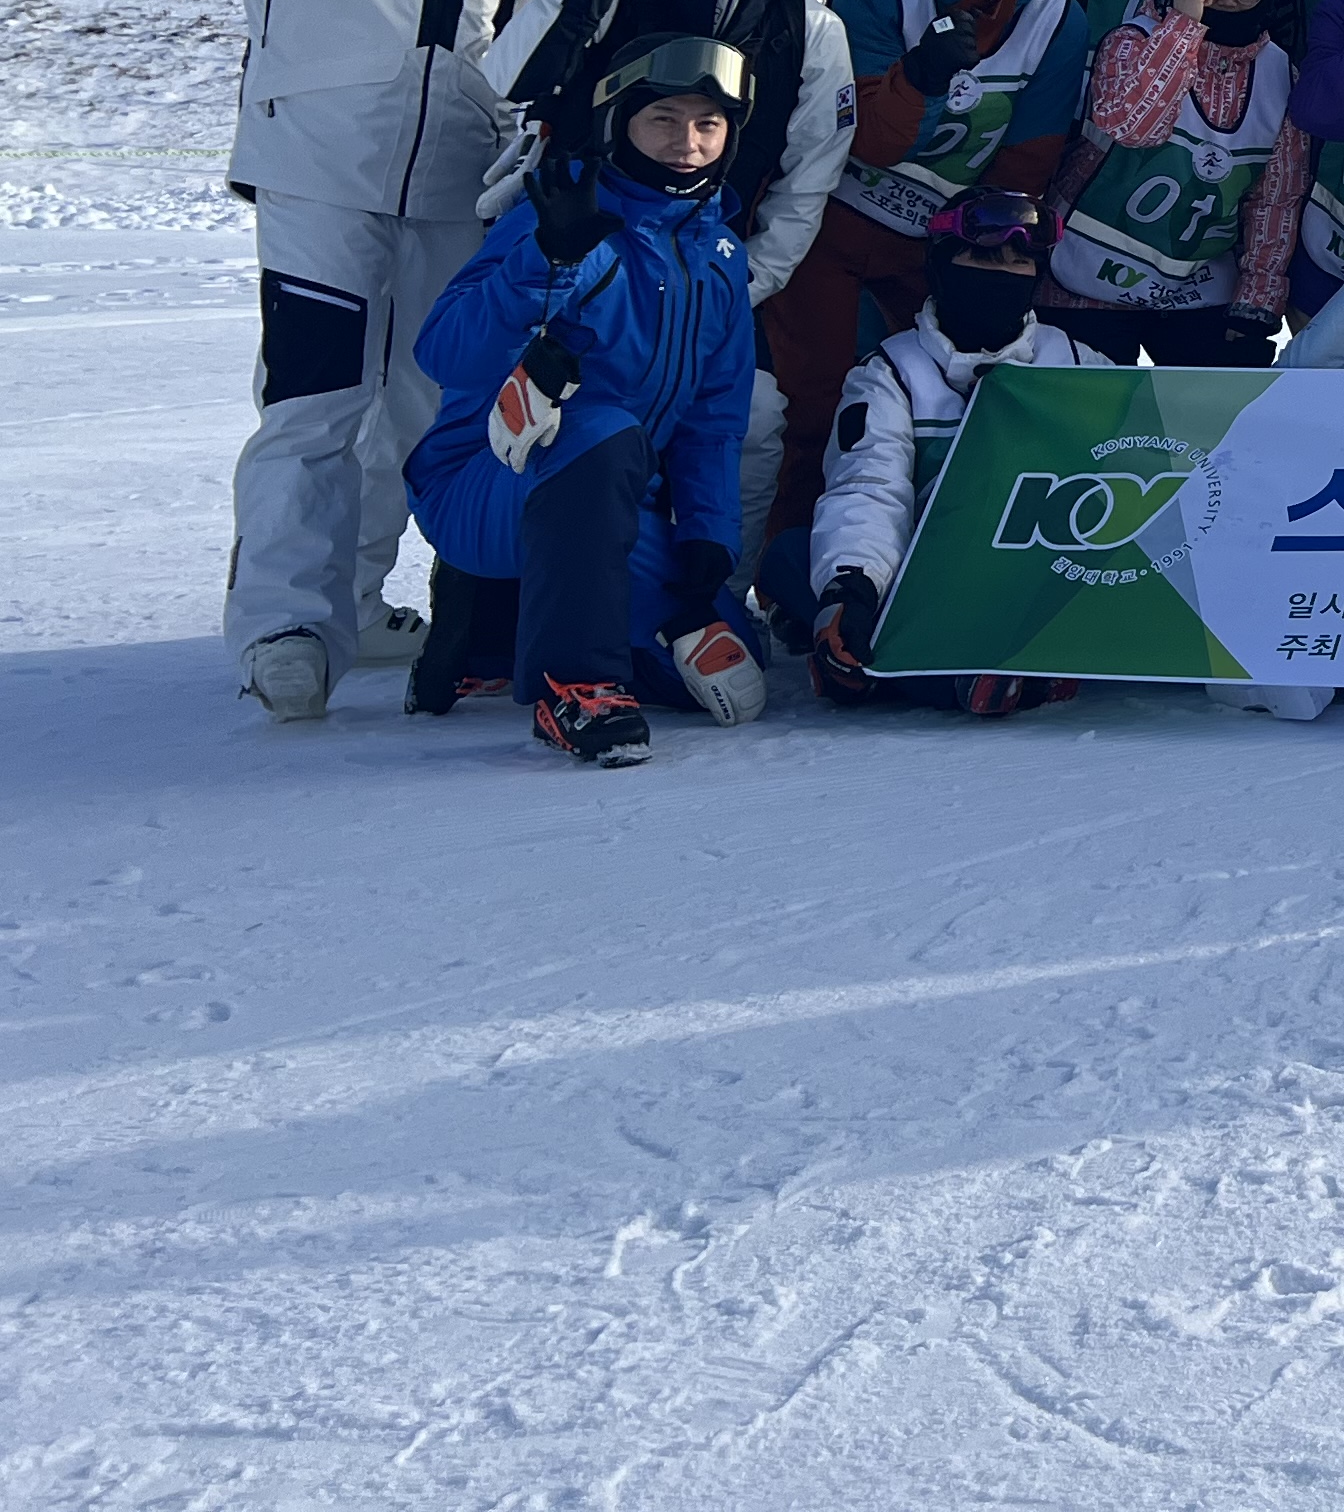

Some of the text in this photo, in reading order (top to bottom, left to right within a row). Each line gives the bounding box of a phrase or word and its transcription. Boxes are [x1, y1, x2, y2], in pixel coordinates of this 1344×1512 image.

[1090, 436, 1223, 535] KONYANG UNIVERSITY
[1050, 555, 1138, 586] 건양대학교
[1151, 541, 1194, 572] 1991
